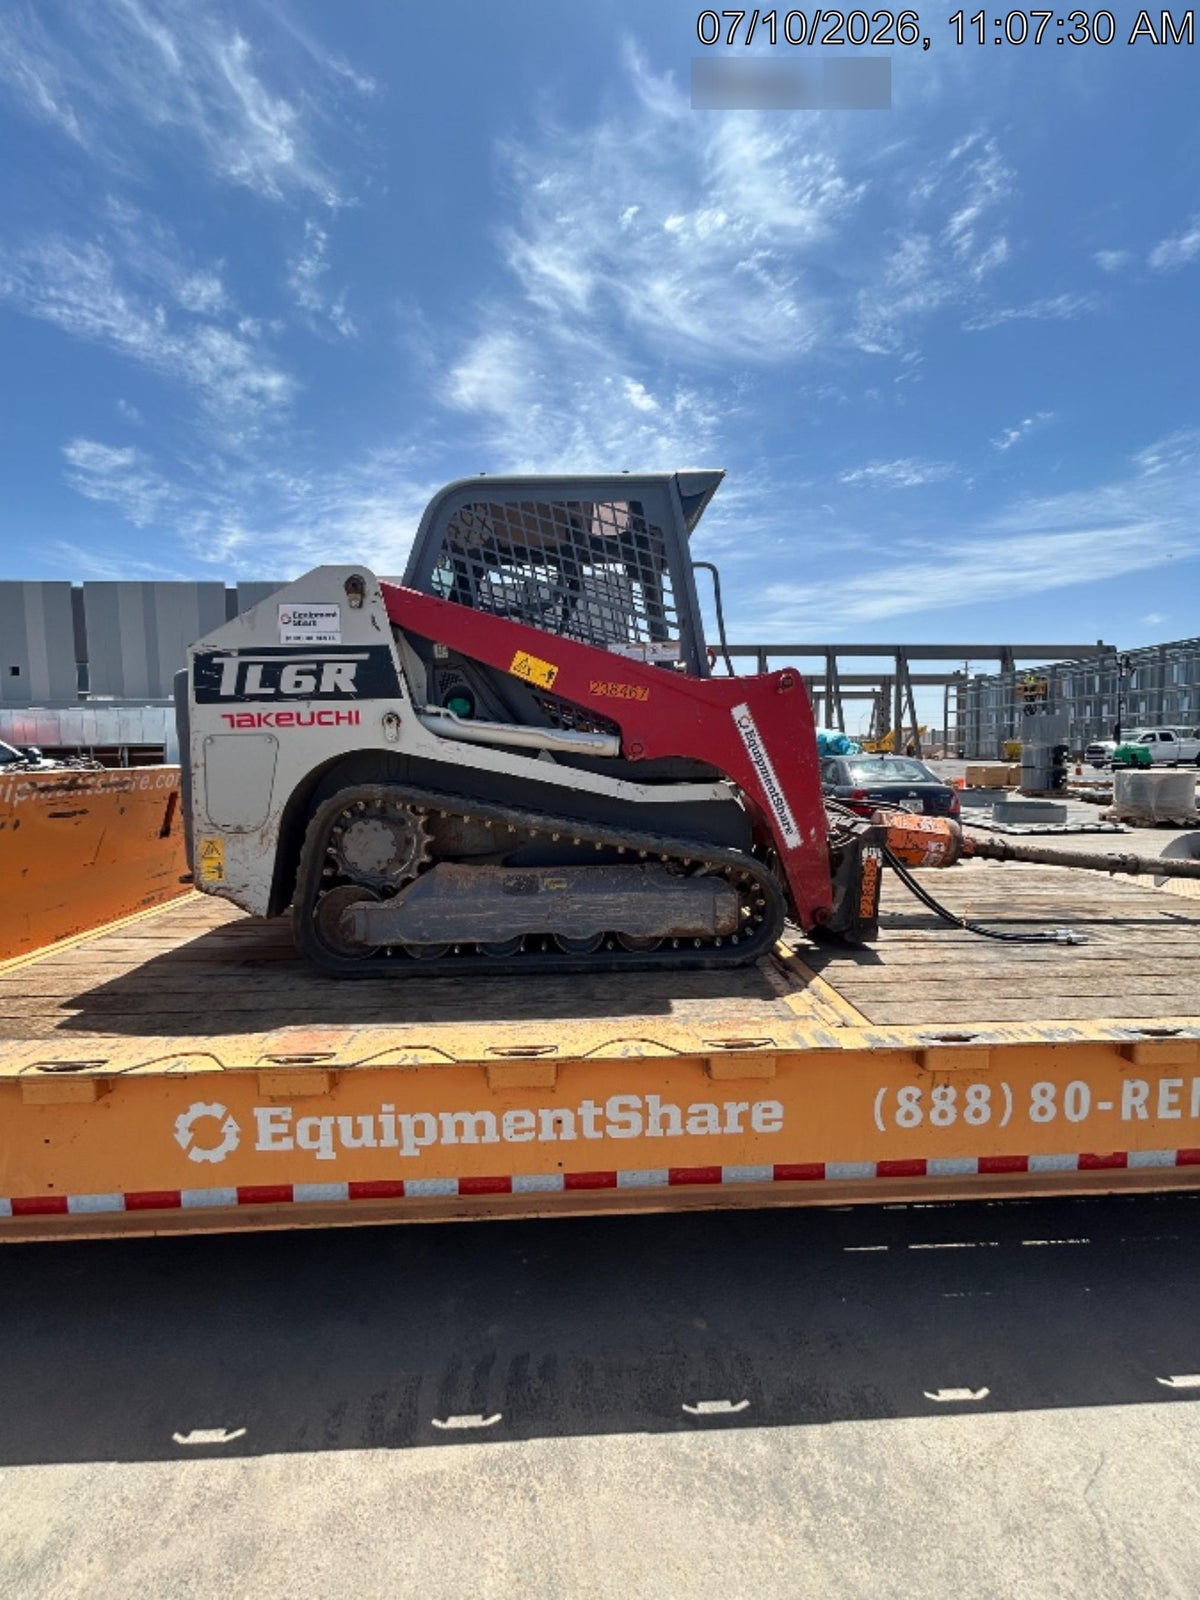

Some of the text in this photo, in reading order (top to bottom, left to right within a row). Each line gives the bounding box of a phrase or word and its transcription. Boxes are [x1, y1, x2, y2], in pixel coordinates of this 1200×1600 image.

[211, 653, 370, 696] TL6R
[744, 728, 794, 836] EquipmentShare
[254, 1094, 784, 1160] EquipmentShare
[874, 1082, 1012, 1132] (888)
